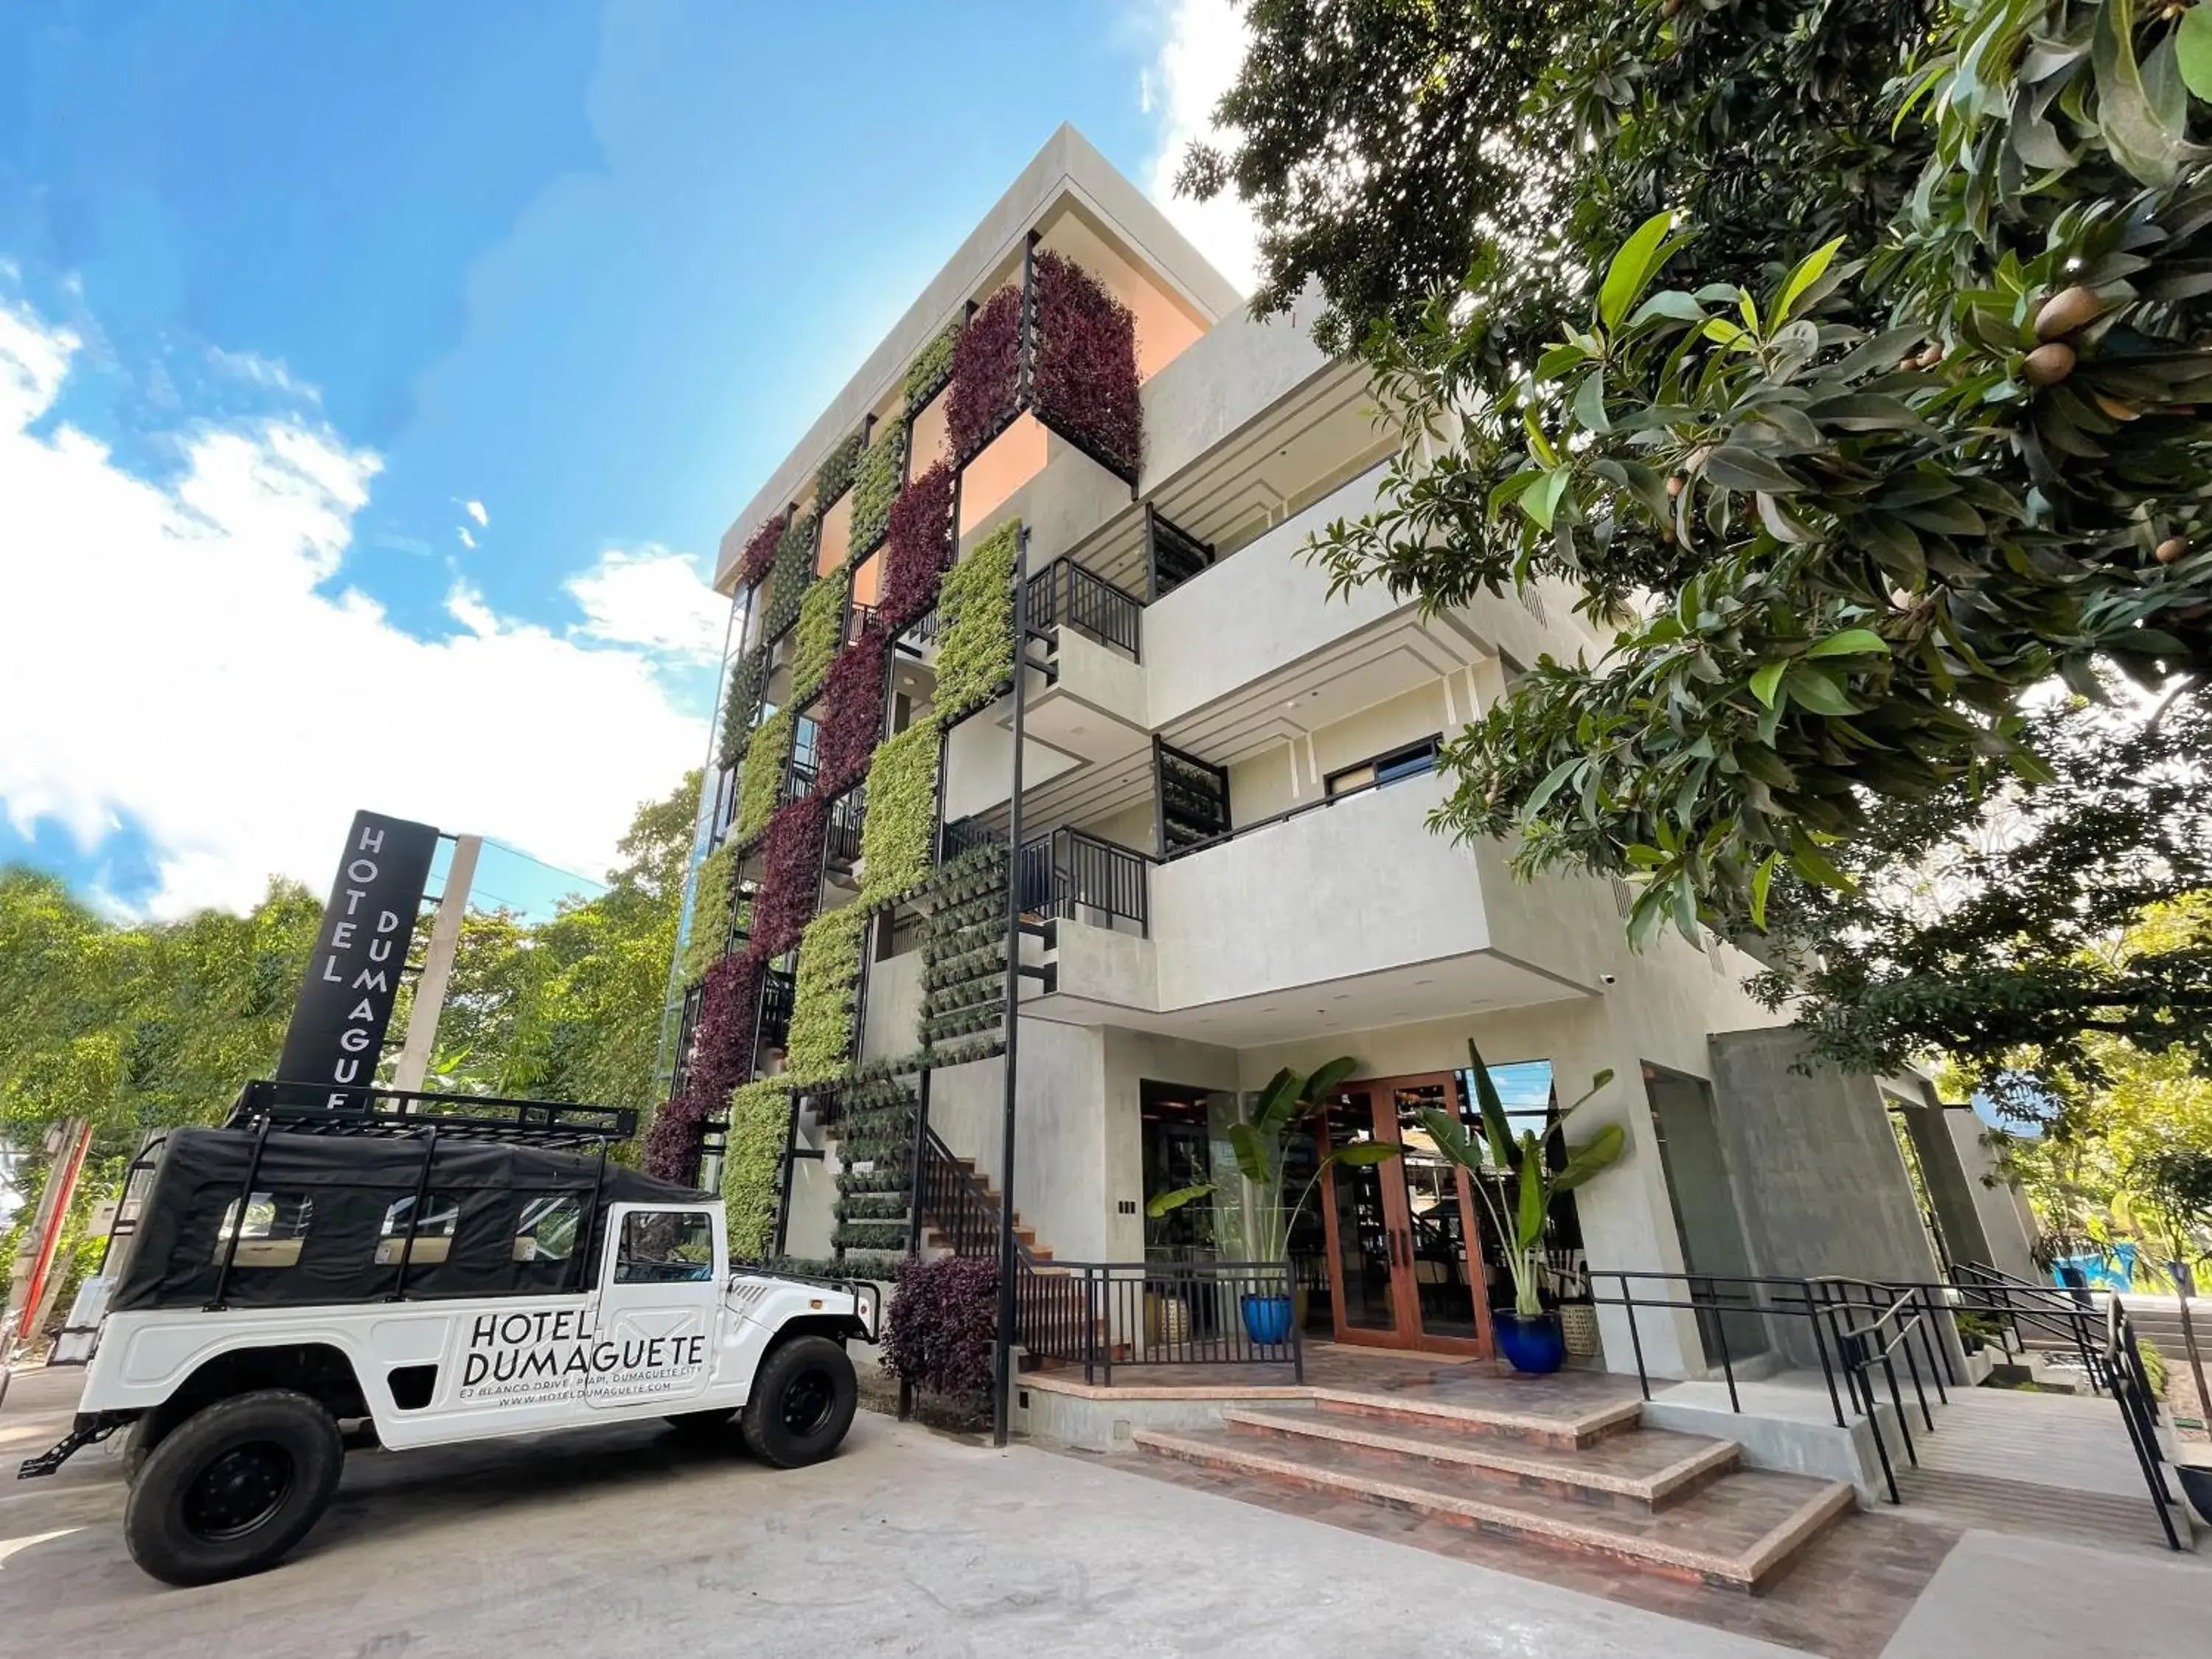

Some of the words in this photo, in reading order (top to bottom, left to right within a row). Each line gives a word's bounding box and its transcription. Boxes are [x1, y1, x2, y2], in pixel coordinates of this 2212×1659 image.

[323, 827, 384, 982] HOTEL
[471, 1310, 592, 1349] HOTEL
[462, 1335, 706, 1386] DUMAGUETE
[479, 1383, 529, 1397] BLANCO
[577, 1376, 608, 1385] PAPI,
[613, 1368, 678, 1382] DUMAGUETE
[680, 1366, 703, 1376] CITY
